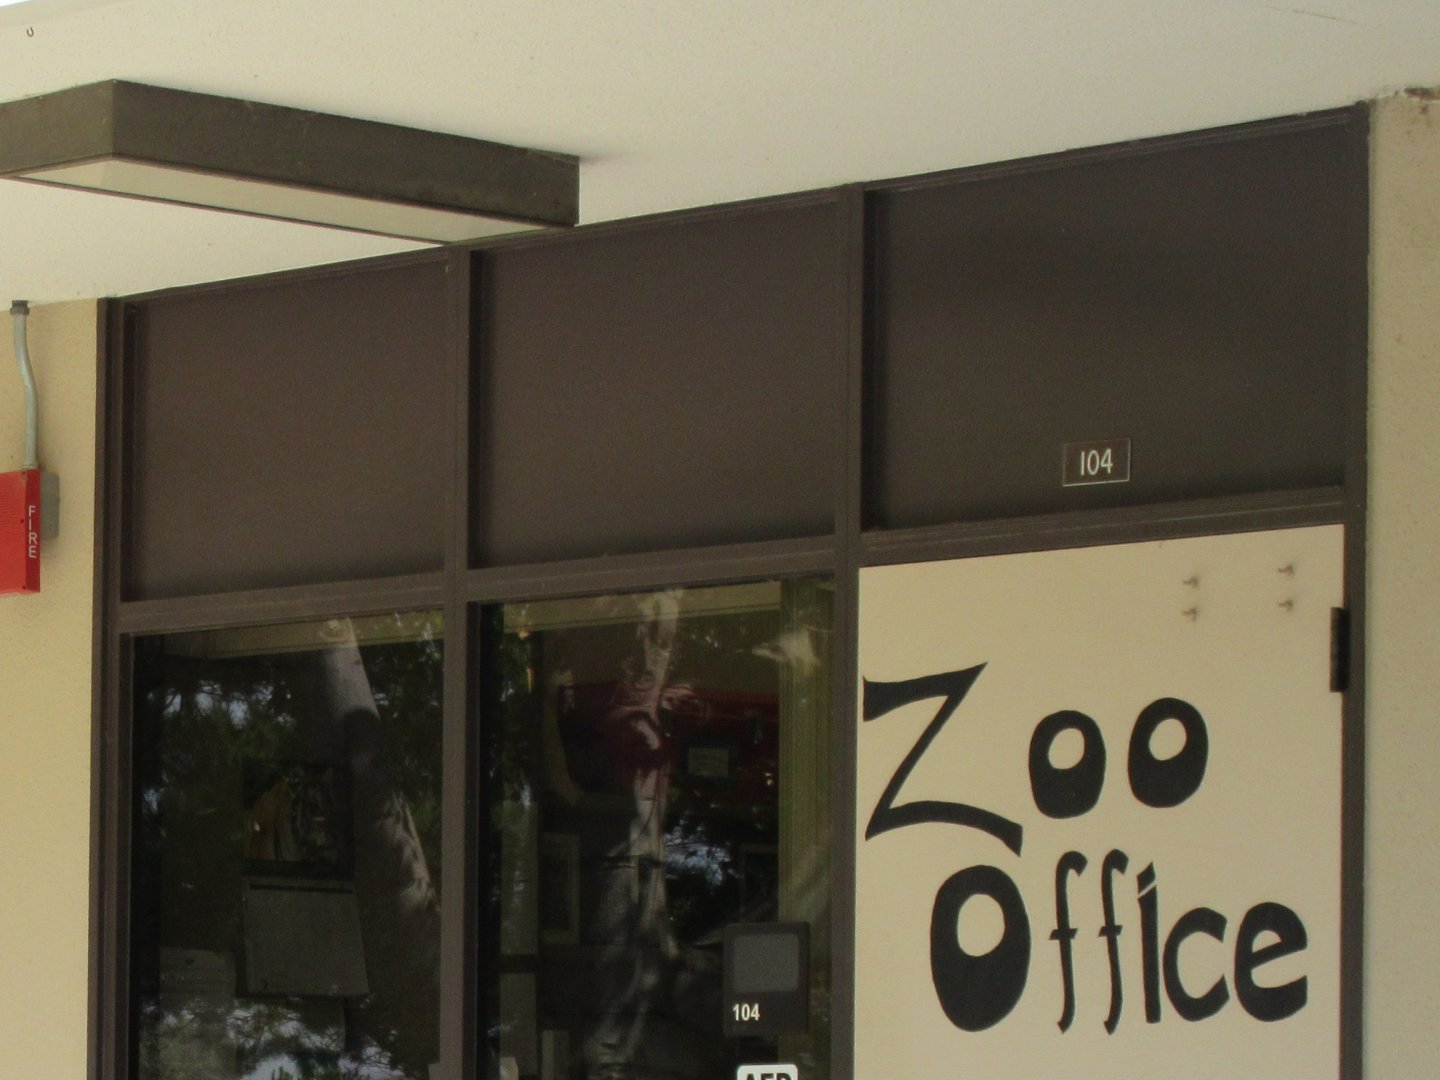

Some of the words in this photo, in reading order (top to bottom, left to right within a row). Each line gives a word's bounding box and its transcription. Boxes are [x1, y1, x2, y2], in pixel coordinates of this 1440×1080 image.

[1080, 448, 1113, 476] 104
[28, 504, 38, 559] FIRE
[862, 661, 1209, 858] Zoo
[930, 848, 1308, 1035] Office
[732, 1003, 760, 1021] 104
